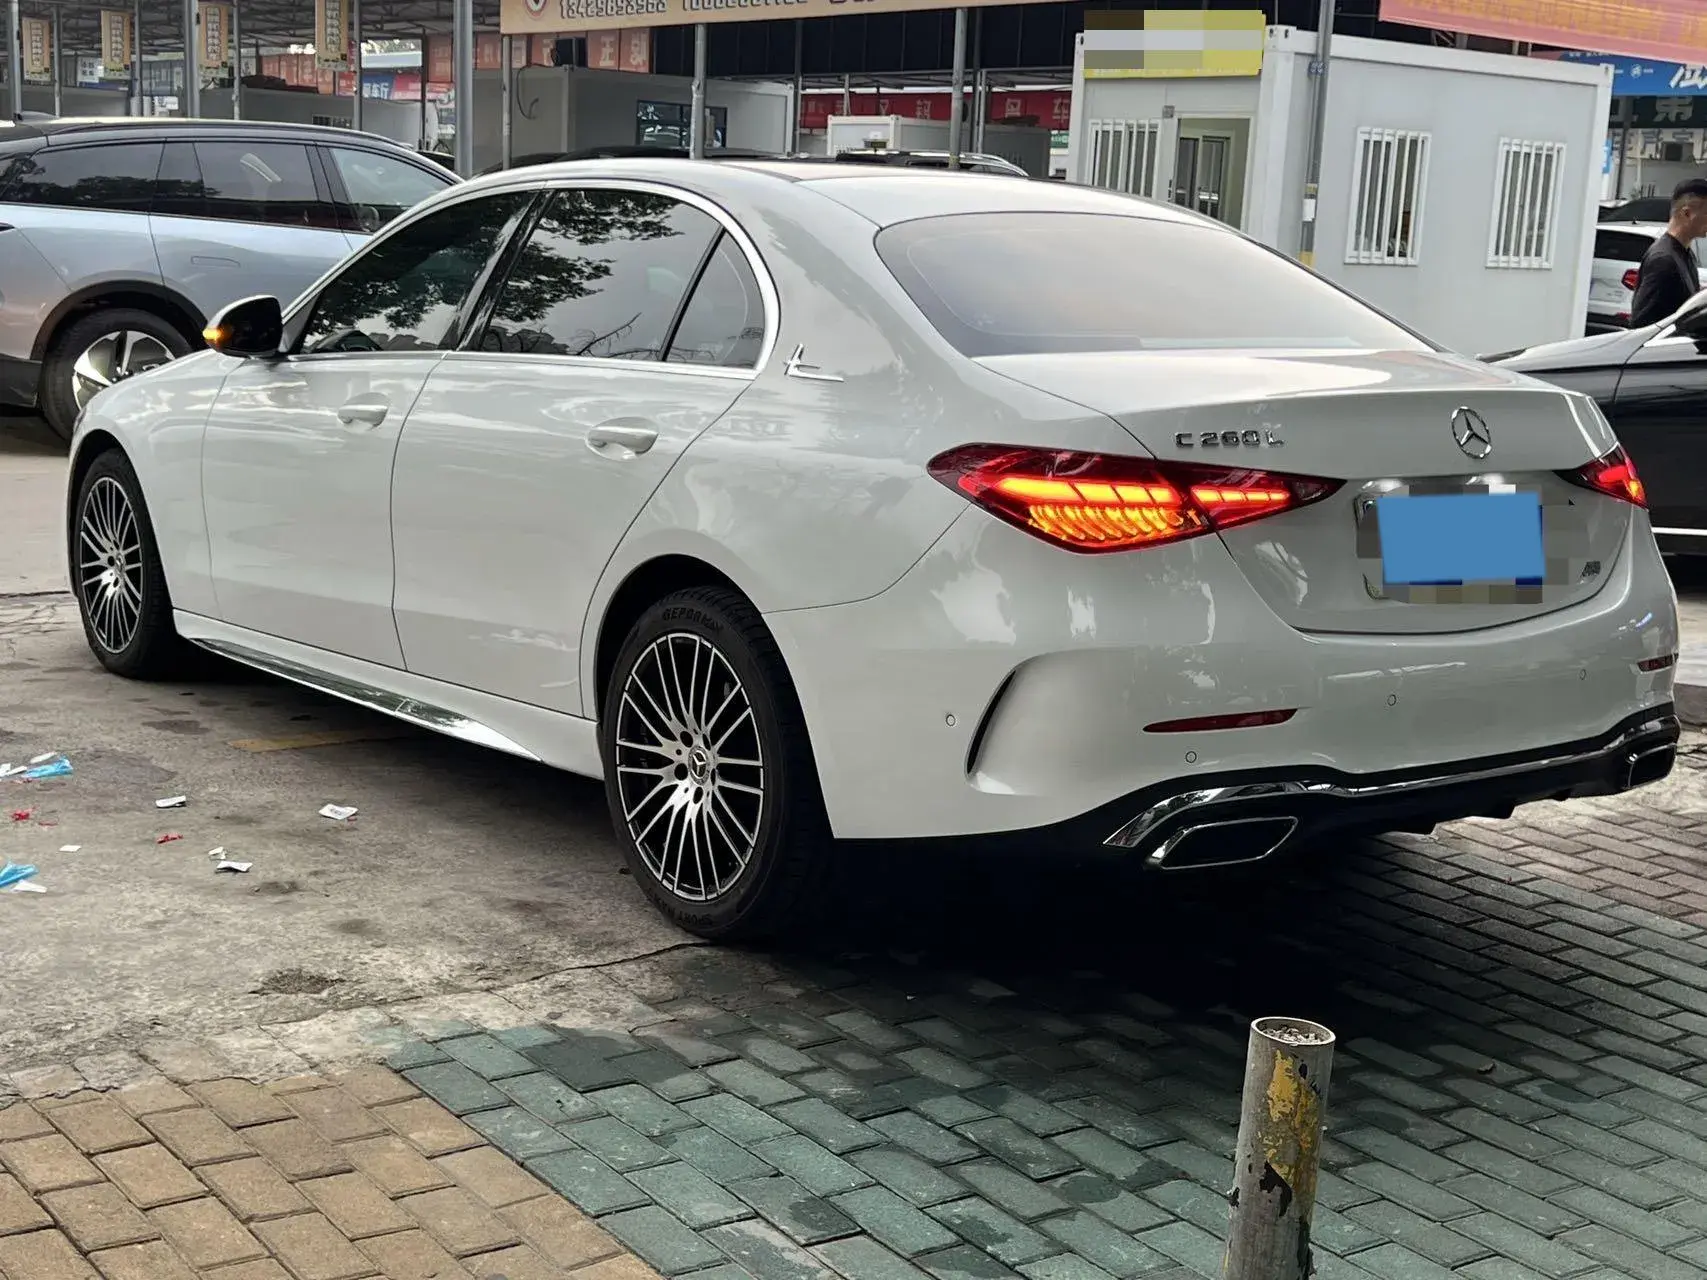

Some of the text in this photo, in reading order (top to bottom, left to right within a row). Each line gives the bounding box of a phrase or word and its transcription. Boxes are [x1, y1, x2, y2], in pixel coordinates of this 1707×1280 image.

[1175, 429, 1285, 447] C 260 L
